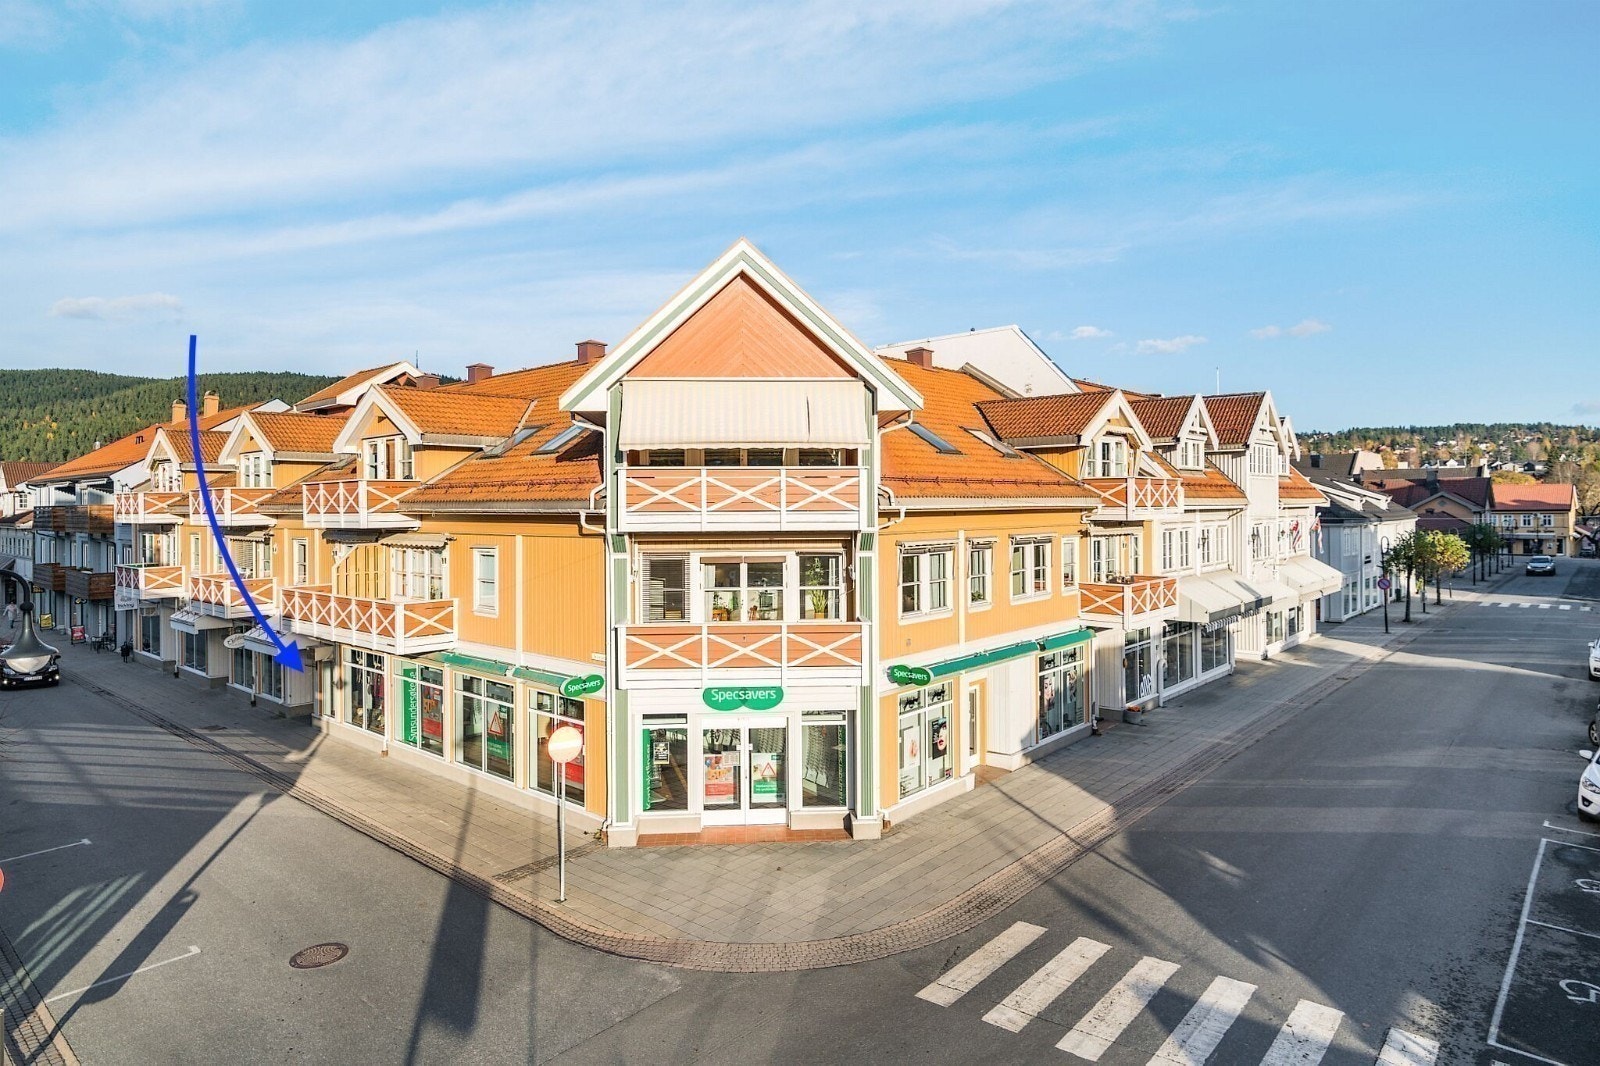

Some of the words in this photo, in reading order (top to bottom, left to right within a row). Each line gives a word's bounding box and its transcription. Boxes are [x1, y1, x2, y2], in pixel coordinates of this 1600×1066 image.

[893, 668, 928, 681] Specsavers
[567, 679, 601, 693] Specsavers
[711, 689, 777, 703] Specsavers
[408, 670, 418, 742] Synsundersøkee
